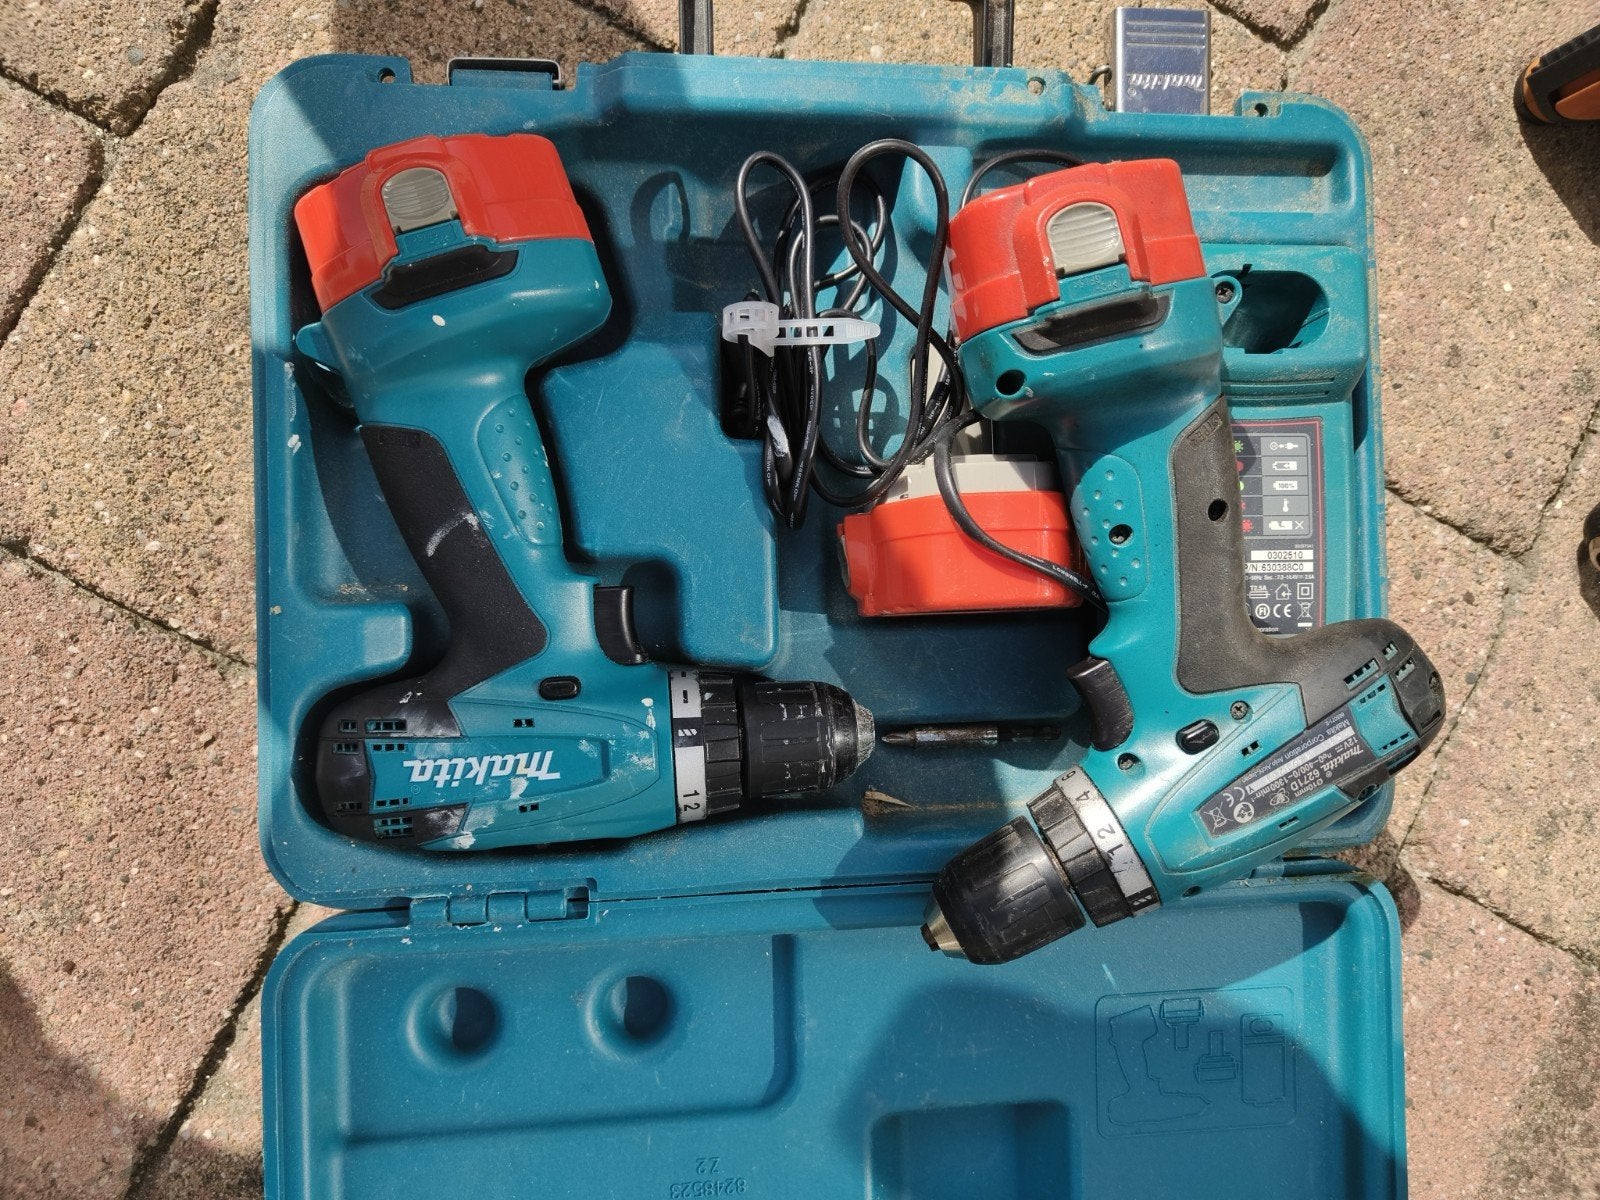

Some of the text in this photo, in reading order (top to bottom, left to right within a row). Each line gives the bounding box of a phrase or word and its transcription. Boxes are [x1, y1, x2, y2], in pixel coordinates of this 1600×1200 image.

[1267, 551, 1304, 560] 0302510
[1326, 718, 1351, 735] Makita
[1284, 733, 1325, 760] Corporation
[1290, 768, 1320, 792] 6271D
[1075, 790, 1090, 801] 4
[1096, 823, 1116, 840] 2
[669, 1177, 747, 1200] 8248523
